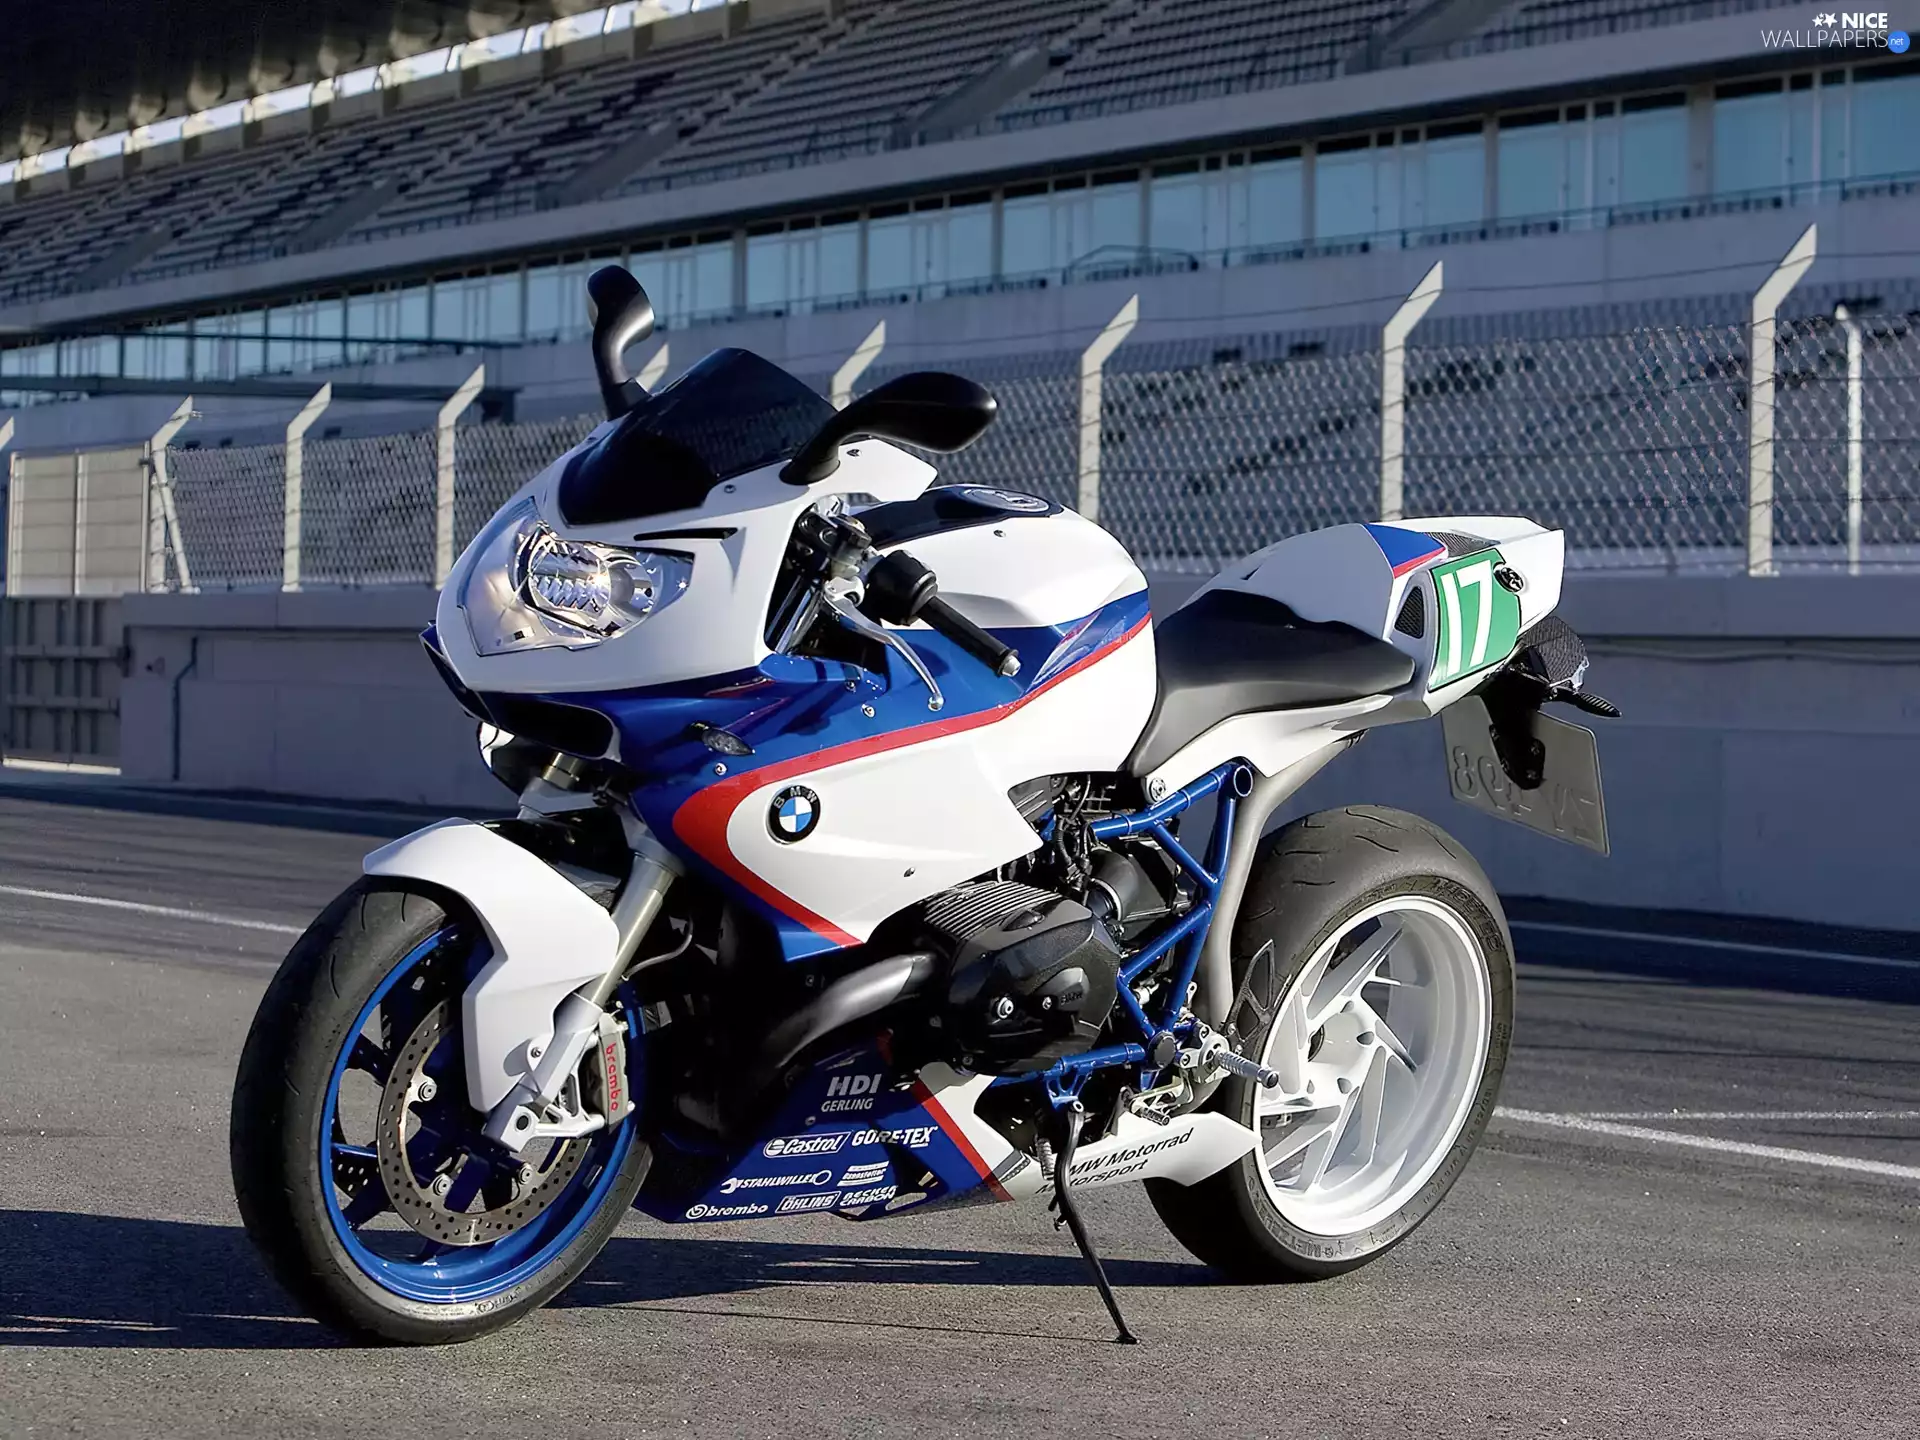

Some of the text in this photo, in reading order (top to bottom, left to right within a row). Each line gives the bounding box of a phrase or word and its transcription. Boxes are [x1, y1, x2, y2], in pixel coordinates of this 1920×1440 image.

[1440, 560, 1491, 676] 17
[774, 786, 817, 809] BMW
[606, 1043, 621, 1110] brembo
[827, 1074, 882, 1097] HDI
[821, 1098, 873, 1112] GERLING
[782, 1135, 843, 1155] Castrol
[1105, 1127, 1194, 1167] Motorrad
[707, 1204, 768, 1217] brembo
